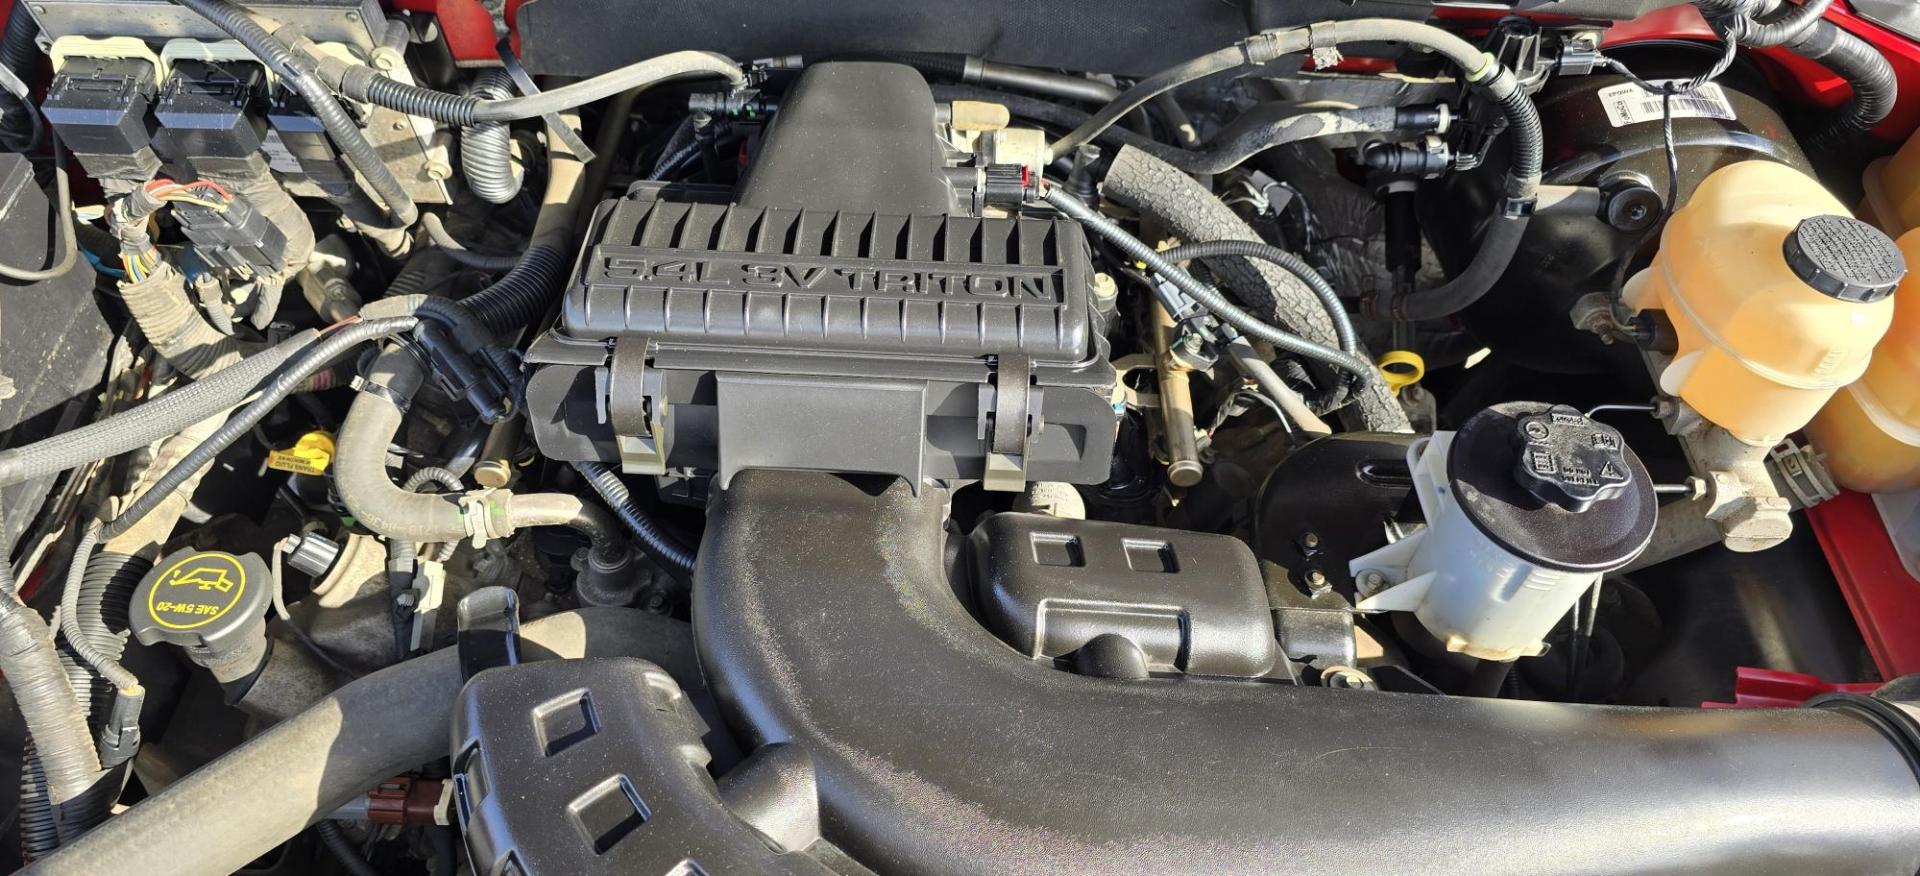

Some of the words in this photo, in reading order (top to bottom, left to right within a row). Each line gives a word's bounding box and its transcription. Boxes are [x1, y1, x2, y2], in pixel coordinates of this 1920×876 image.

[603, 255, 730, 286] 5.4L
[741, 261, 828, 291] 3V
[836, 266, 1052, 301] TRITON
[295, 464, 315, 473] TRANS
[156, 601, 193, 614] 5W-20
[194, 604, 220, 615] SAE
